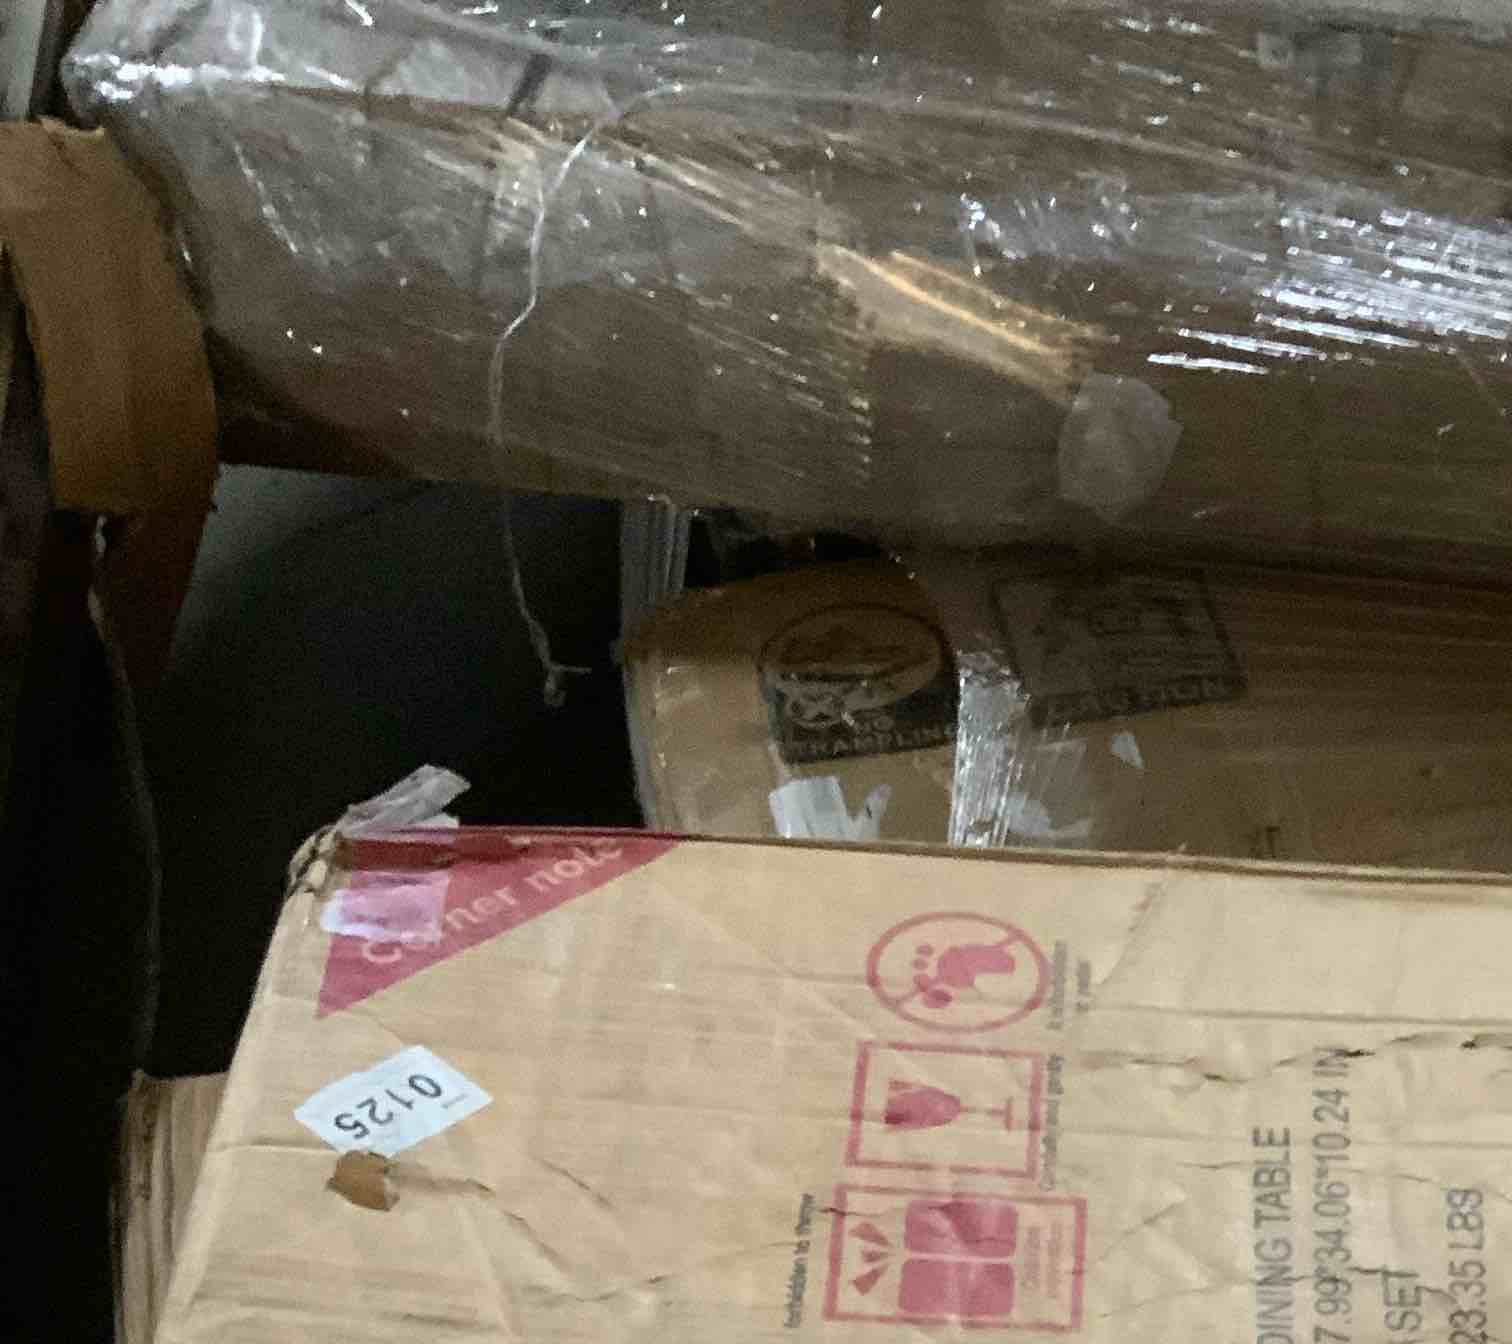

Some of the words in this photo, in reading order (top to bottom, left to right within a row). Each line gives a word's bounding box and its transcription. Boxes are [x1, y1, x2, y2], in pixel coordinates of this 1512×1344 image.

[333, 1072, 444, 1140] 0125
[1252, 1126, 1293, 1230] TABLE
[1446, 1187, 1486, 1252] LBS
[1382, 1268, 1424, 1331] SET
